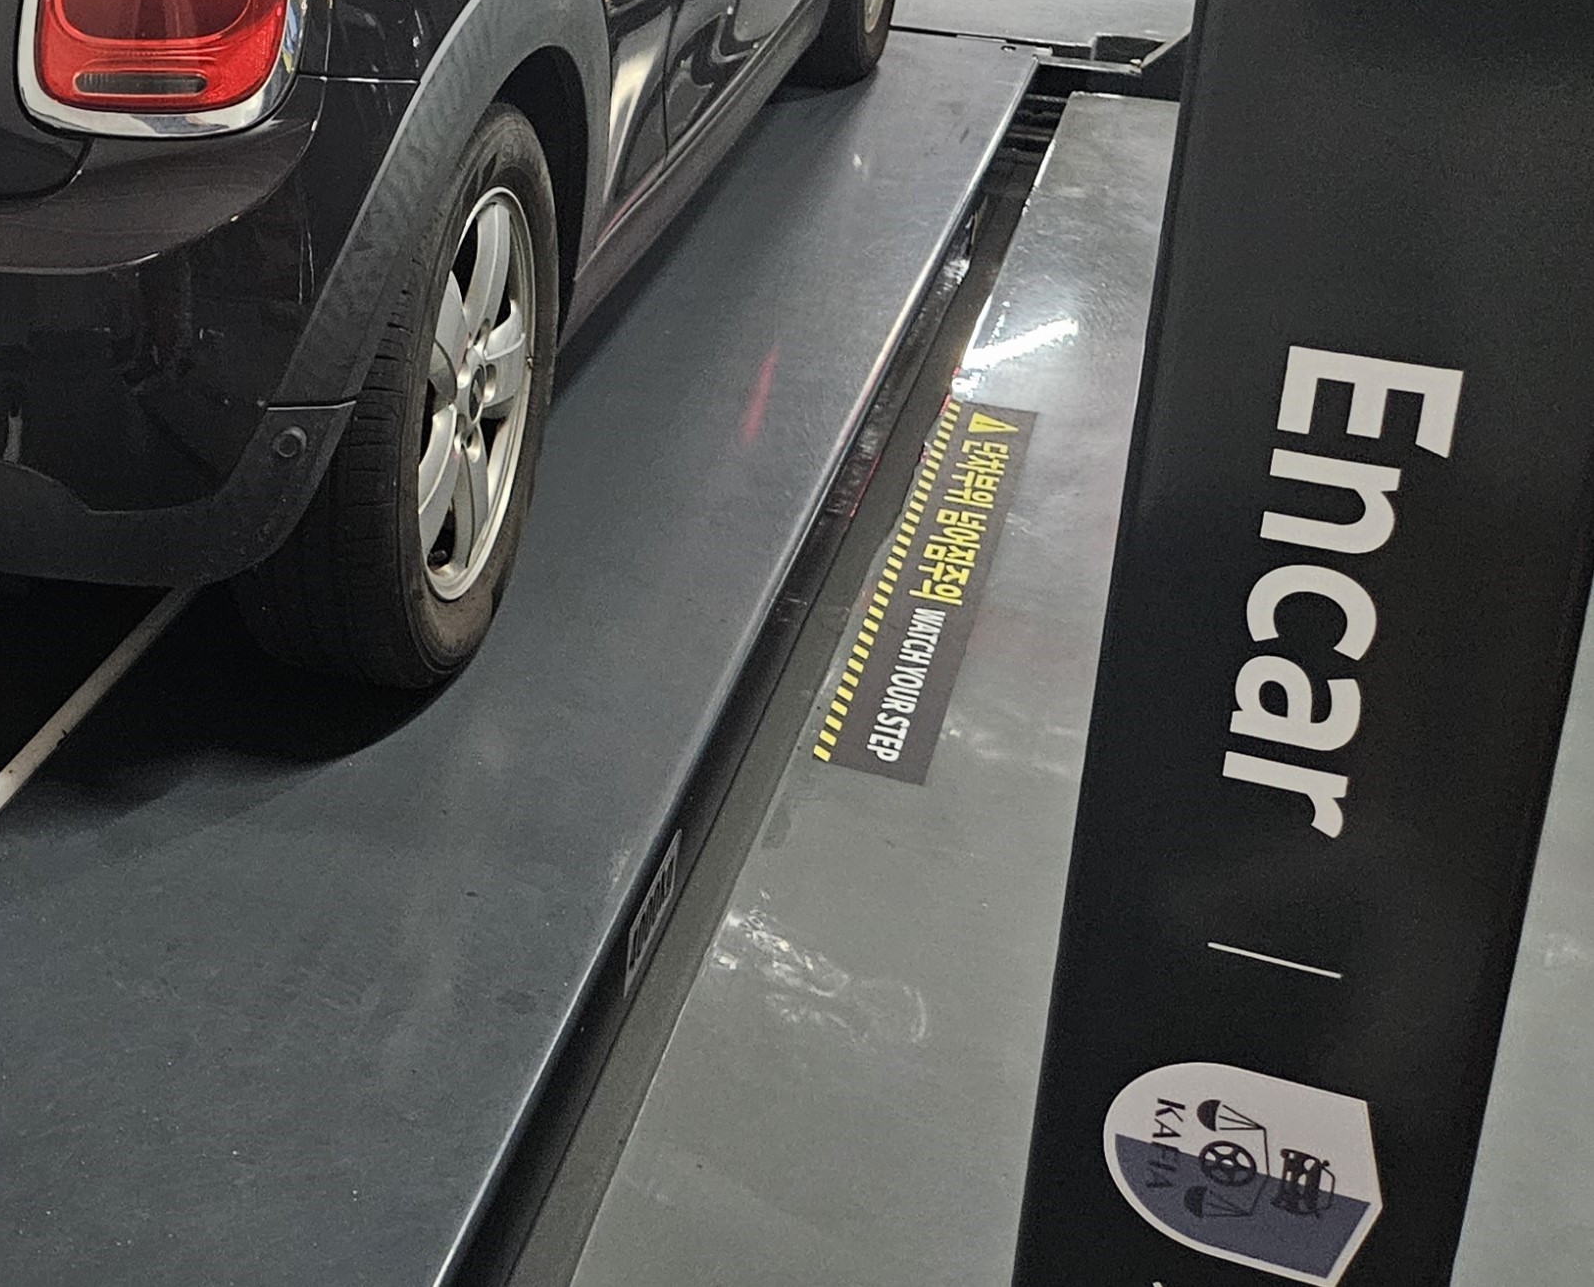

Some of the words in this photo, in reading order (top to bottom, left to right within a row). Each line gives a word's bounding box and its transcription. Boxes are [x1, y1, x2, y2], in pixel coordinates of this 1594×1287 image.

[943, 439, 1010, 509] 단차부위
[1222, 345, 1464, 839] Encar
[897, 607, 946, 665] WATCH
[880, 665, 928, 714] YOUR
[866, 712, 911, 763] STEP
